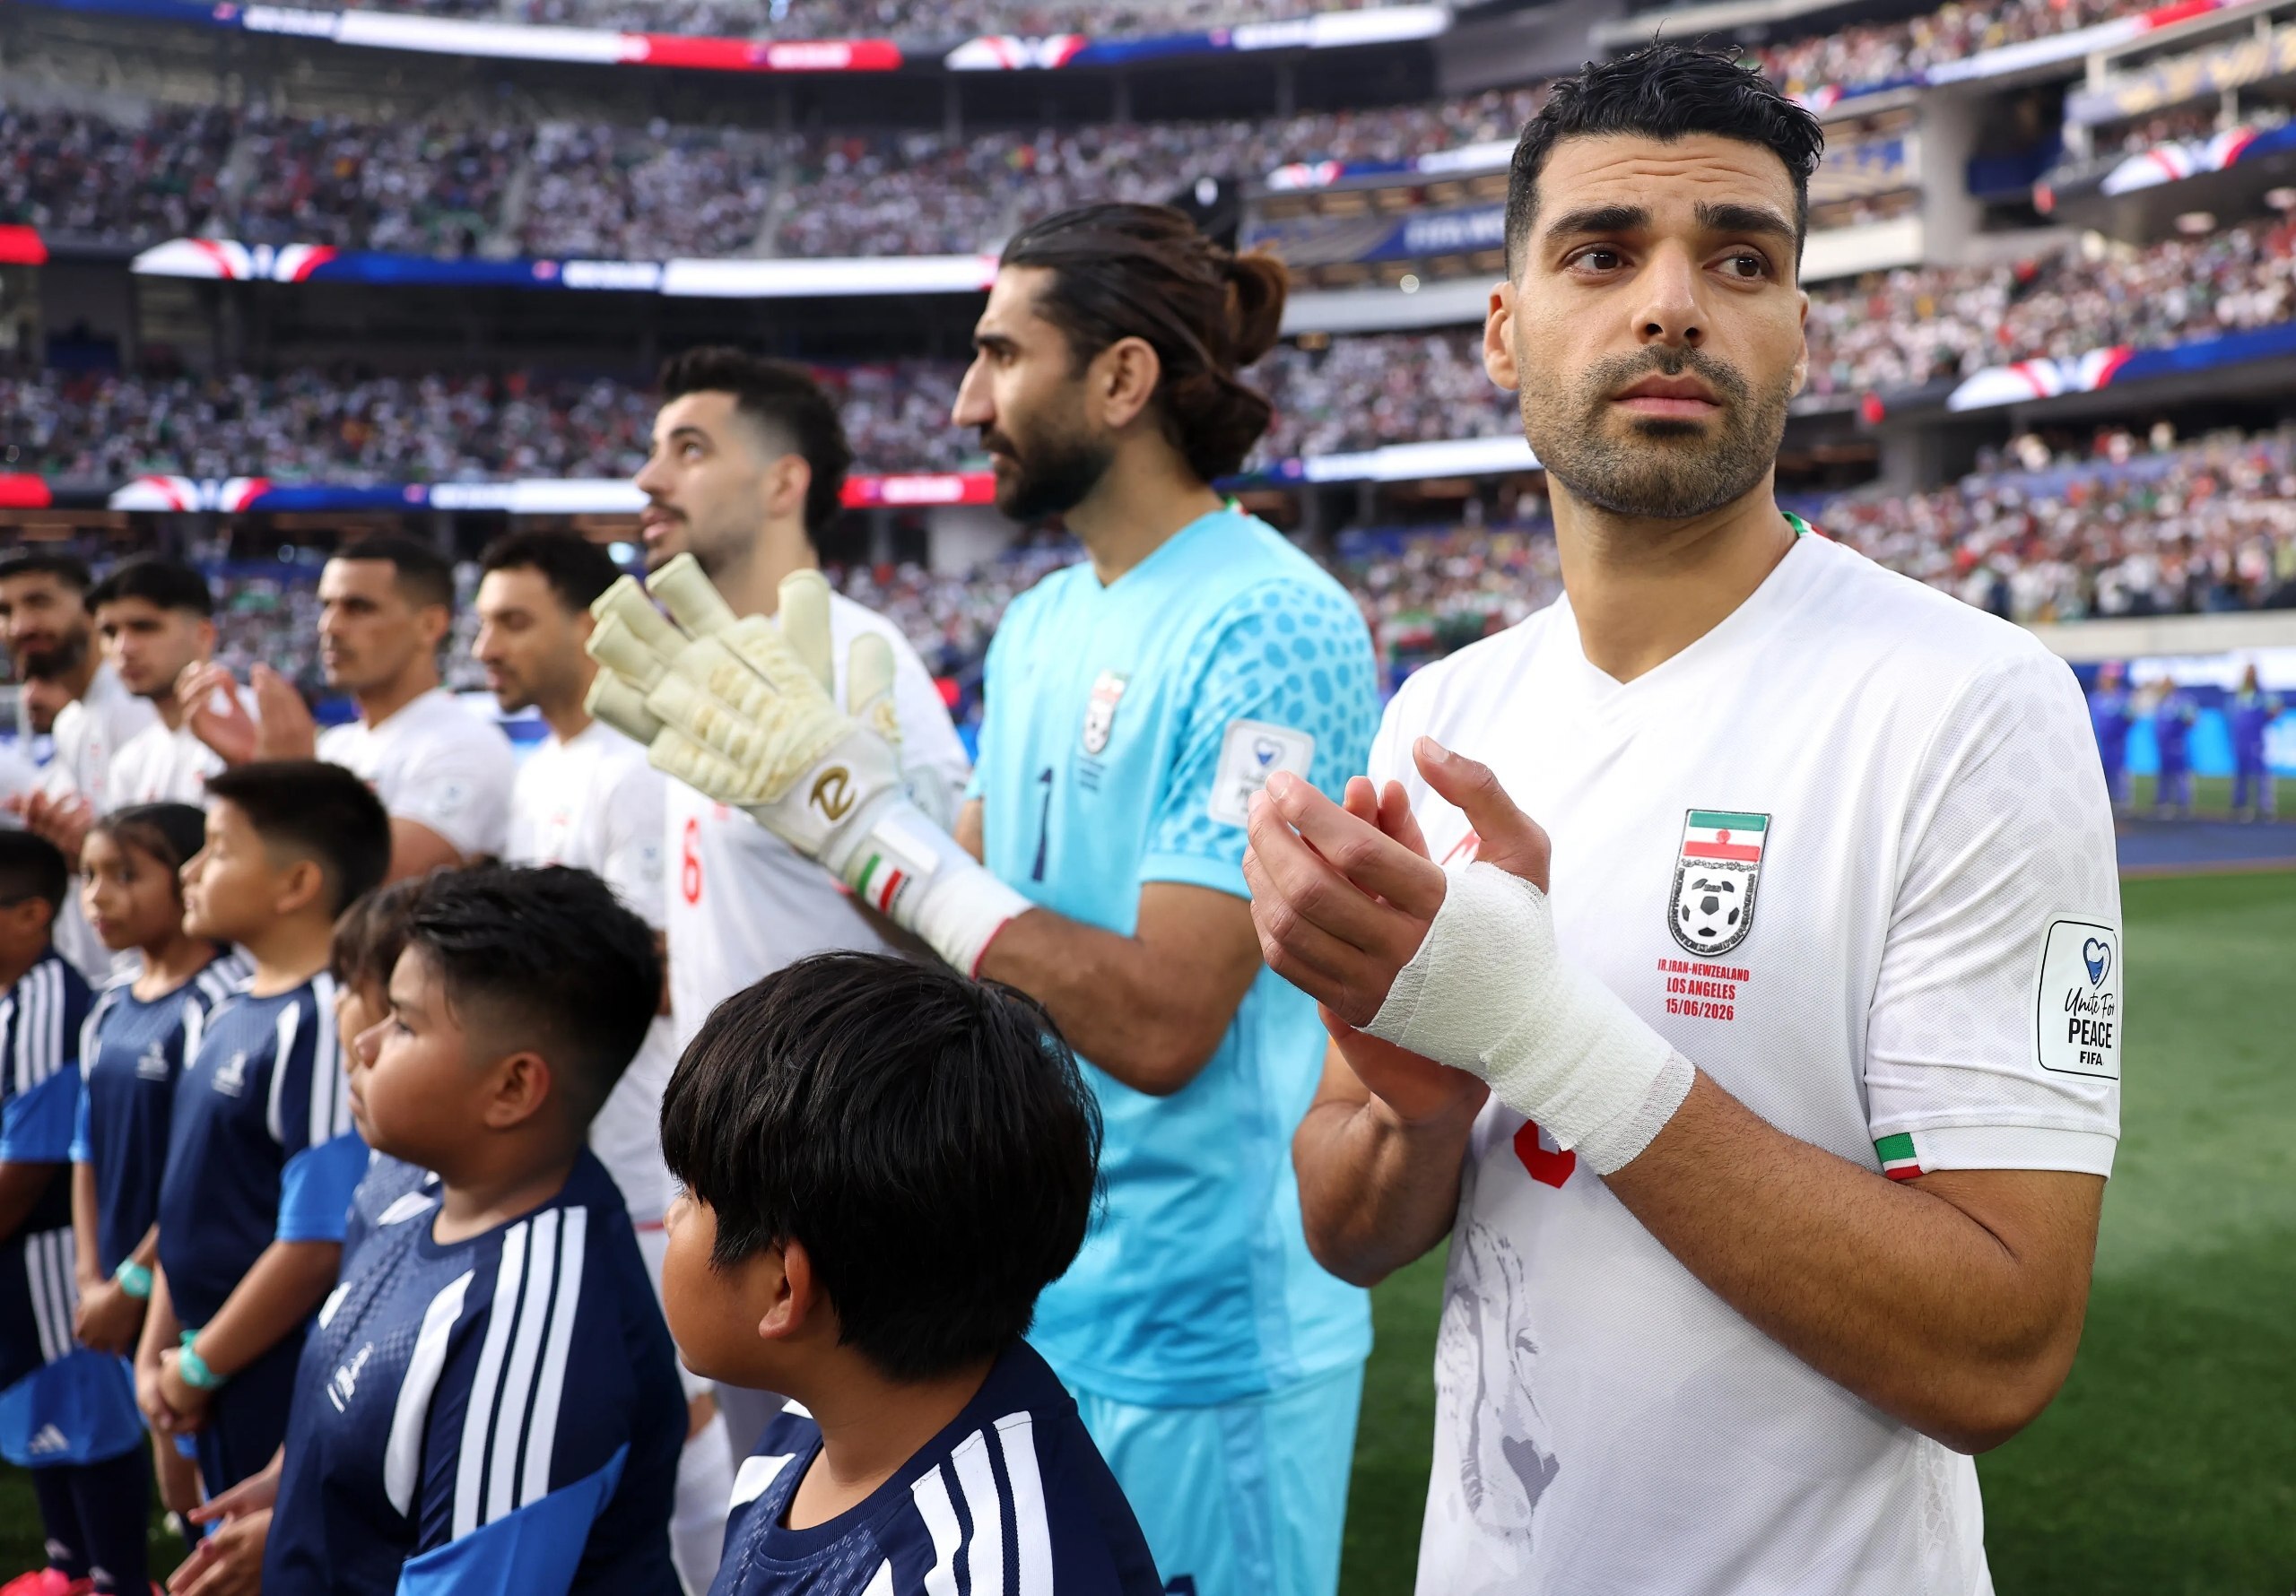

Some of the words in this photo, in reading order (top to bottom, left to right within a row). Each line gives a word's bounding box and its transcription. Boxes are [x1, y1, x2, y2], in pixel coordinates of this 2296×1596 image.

[1031, 768, 1052, 881] 1
[682, 817, 702, 904] 6
[1657, 958, 1750, 982] IR.IRAN-NEWZEALAND
[1666, 976, 1686, 994] LOS
[1687, 980, 1736, 1001] ANGELES
[2065, 986, 2100, 1017] Unite
[1665, 998, 1735, 1021] 15/06/2026
[2068, 1018, 2113, 1049] PEACE
[2079, 1050, 2103, 1066] FIFA
